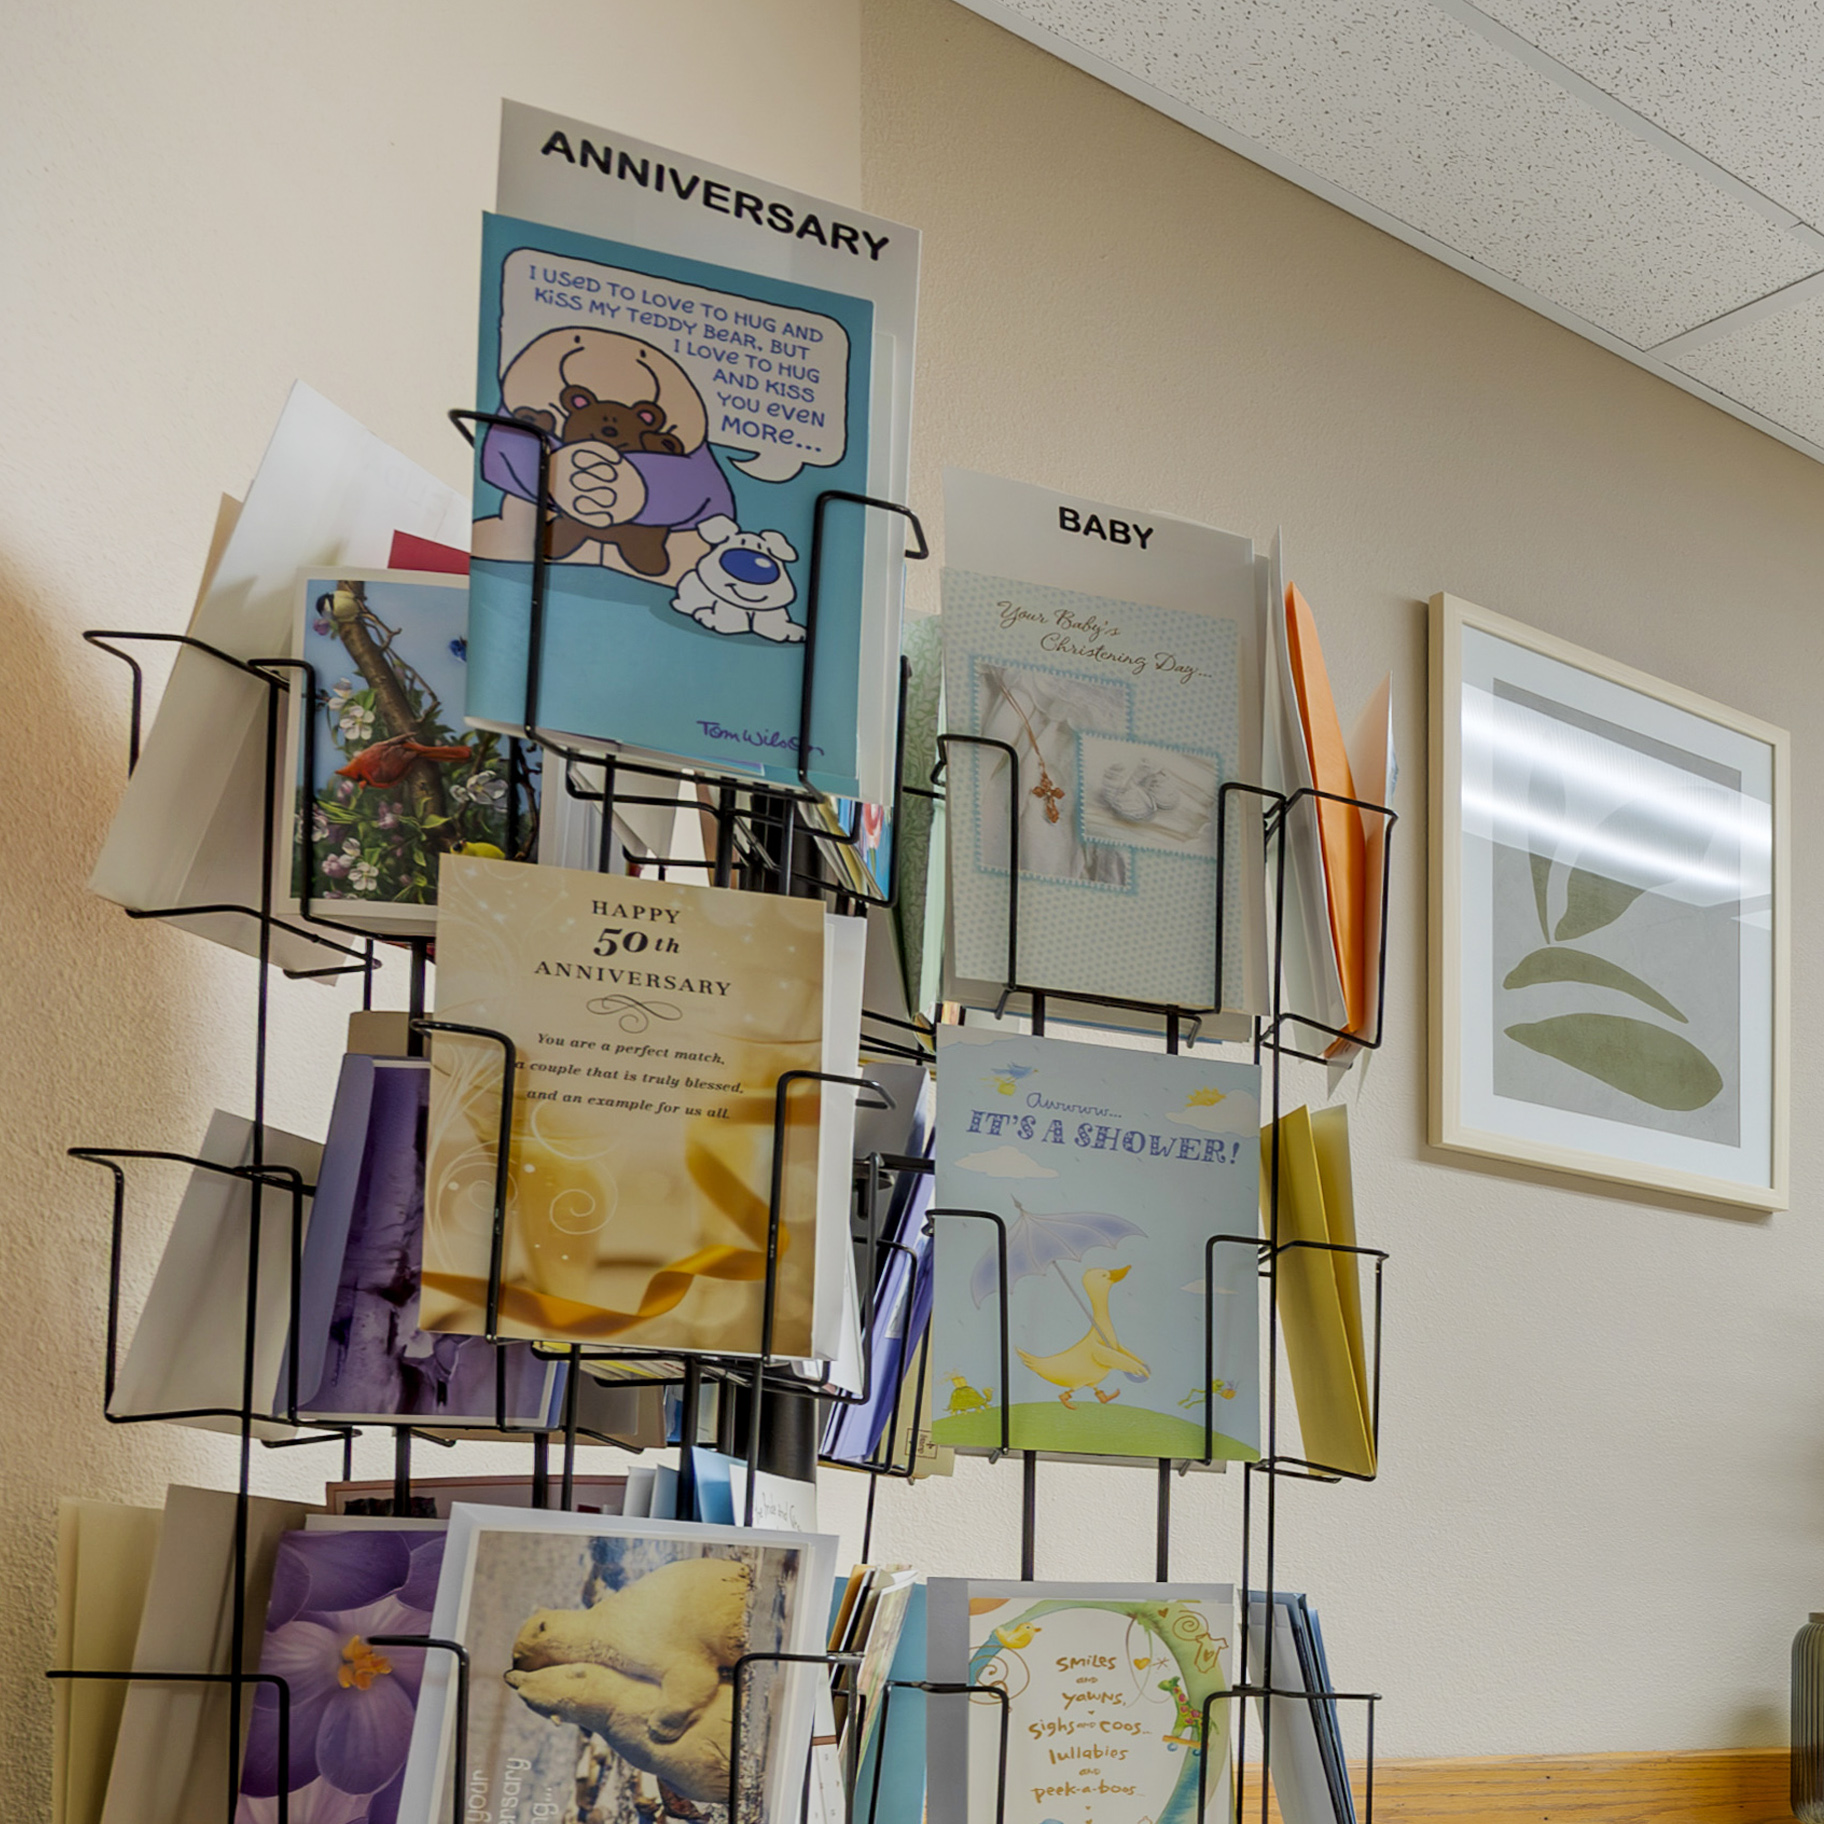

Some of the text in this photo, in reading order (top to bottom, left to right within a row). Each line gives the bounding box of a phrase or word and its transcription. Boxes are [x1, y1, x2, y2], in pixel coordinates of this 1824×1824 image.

[541, 130, 890, 262] ANNIVERSARY
[529, 265, 537, 280] I
[607, 281, 636, 301] TO
[701, 303, 728, 322] TO
[735, 311, 776, 333] HUG
[782, 322, 824, 343] AND
[589, 299, 811, 360] MY BUT
[673, 339, 680, 353] I
[745, 354, 773, 373] TO
[778, 363, 820, 384] HUG
[712, 368, 816, 403] AND KISS
[716, 391, 760, 414] YOU
[1057, 505, 1155, 551] BABY
[998, 601, 1121, 644] Your Baby's
[1039, 633, 1150, 676] Christening
[696, 720, 741, 743] Tom
[591, 900, 681, 924] HAPPY
[534, 961, 732, 997] ANNIVERSARY
[537, 1033, 565, 1046] You
[570, 1038, 596, 1050] are
[601, 1043, 611, 1051] a
[614, 1042, 669, 1059] perfect
[515, 1061, 525, 1070] a
[530, 1061, 582, 1076] couple
[586, 1066, 619, 1080] that
[623, 1070, 637, 1081] is
[642, 1073, 681, 1089] truly
[526, 1089, 558, 1101] and
[562, 1094, 583, 1103] an
[587, 1095, 653, 1112] example
[654, 1101, 681, 1114] for
[684, 1107, 701, 1116] us
[966, 1109, 1242, 1165] IT'S A SHOWER!
[1048, 1745, 1129, 1764] lullabies
[467, 1770, 492, 1822] your
